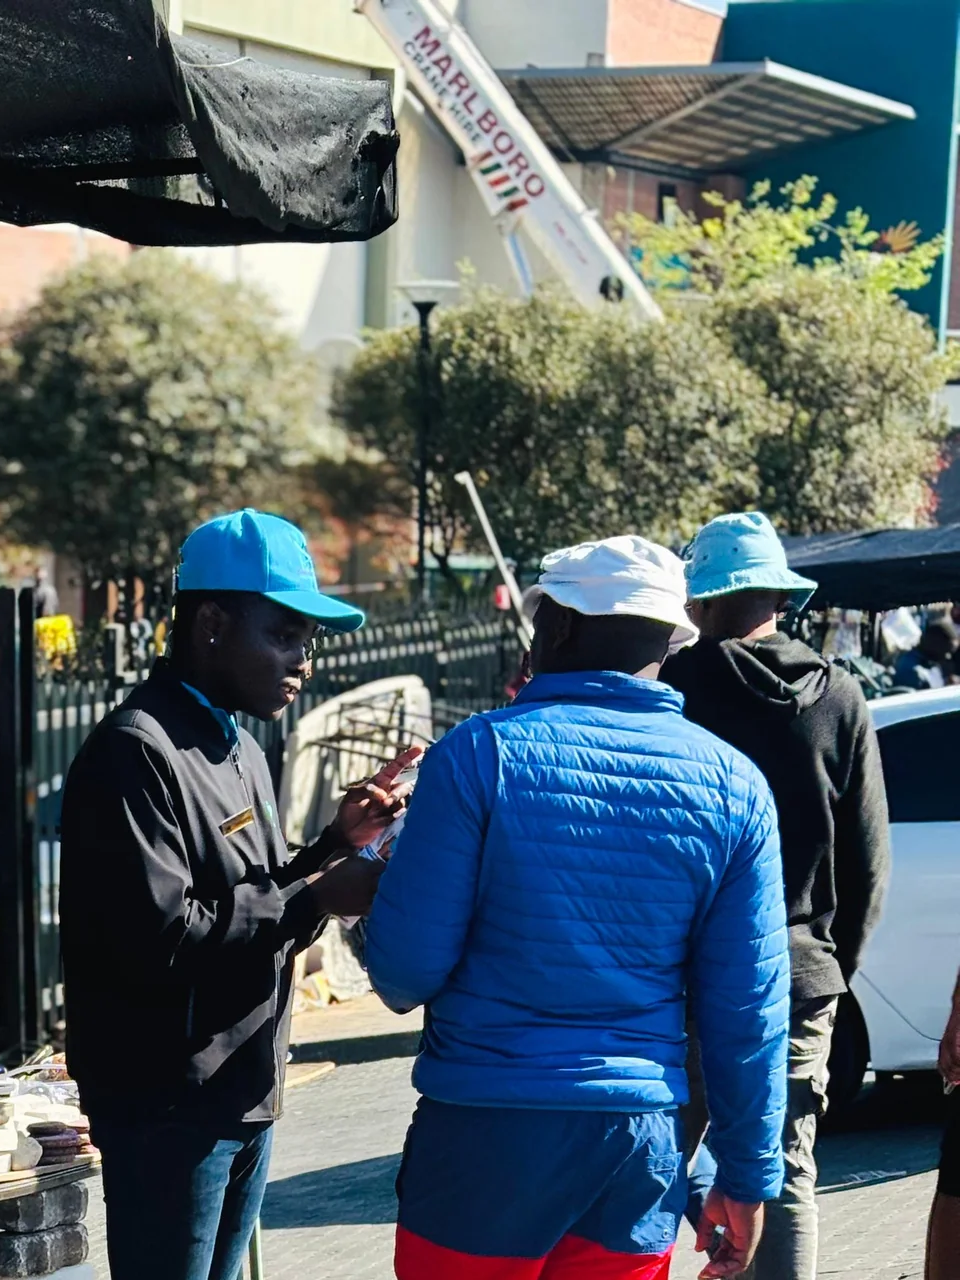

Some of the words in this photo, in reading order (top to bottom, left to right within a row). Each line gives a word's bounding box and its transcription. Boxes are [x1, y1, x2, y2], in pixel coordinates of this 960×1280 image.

[403, 41, 447, 96] CRANE
[448, 102, 483, 143] HIRE
[414, 25, 545, 197] MARLBORO
